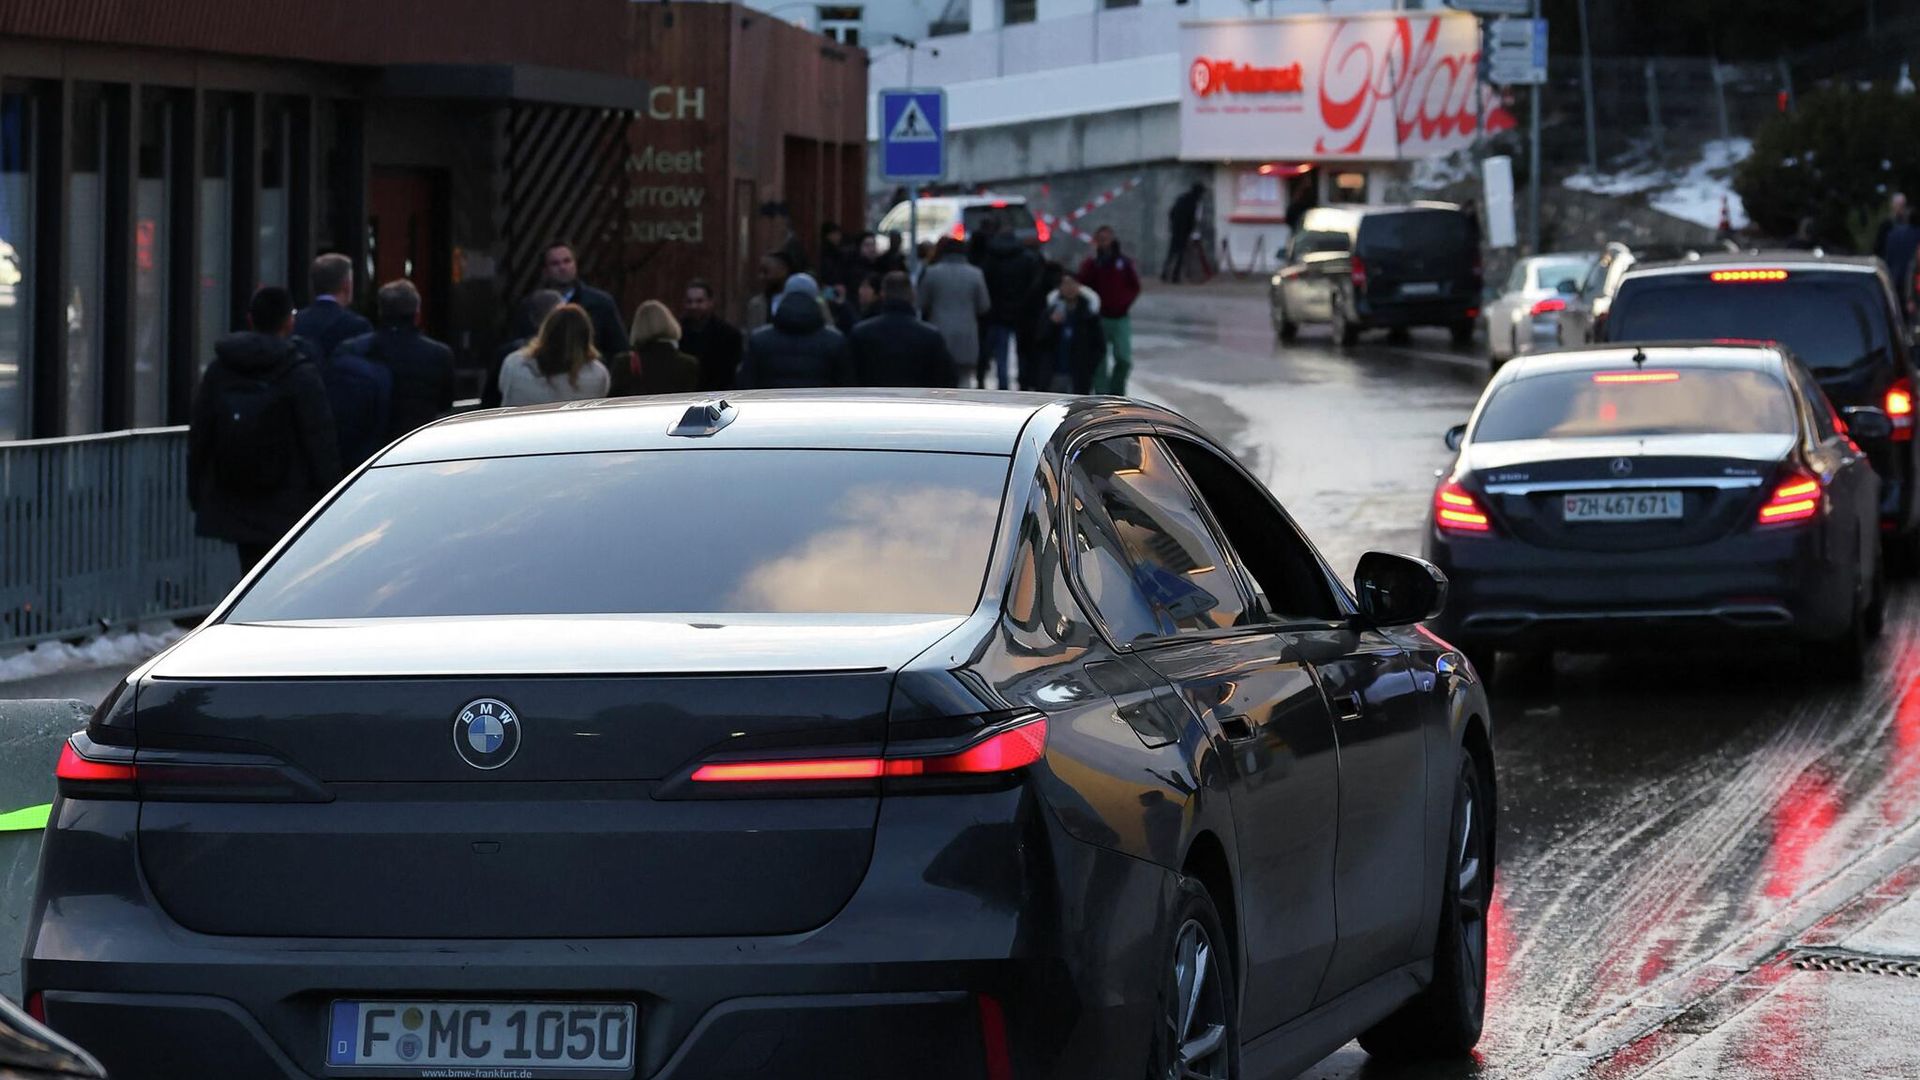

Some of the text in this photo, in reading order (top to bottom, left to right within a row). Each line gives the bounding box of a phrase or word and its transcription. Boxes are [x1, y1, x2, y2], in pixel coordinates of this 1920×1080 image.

[461, 703, 513, 724] BMW
[362, 1009, 630, 1060] F MC 1050
[337, 1041, 348, 1054] D
[421, 1068, 533, 1079] www.bmw-frankfurt.de
